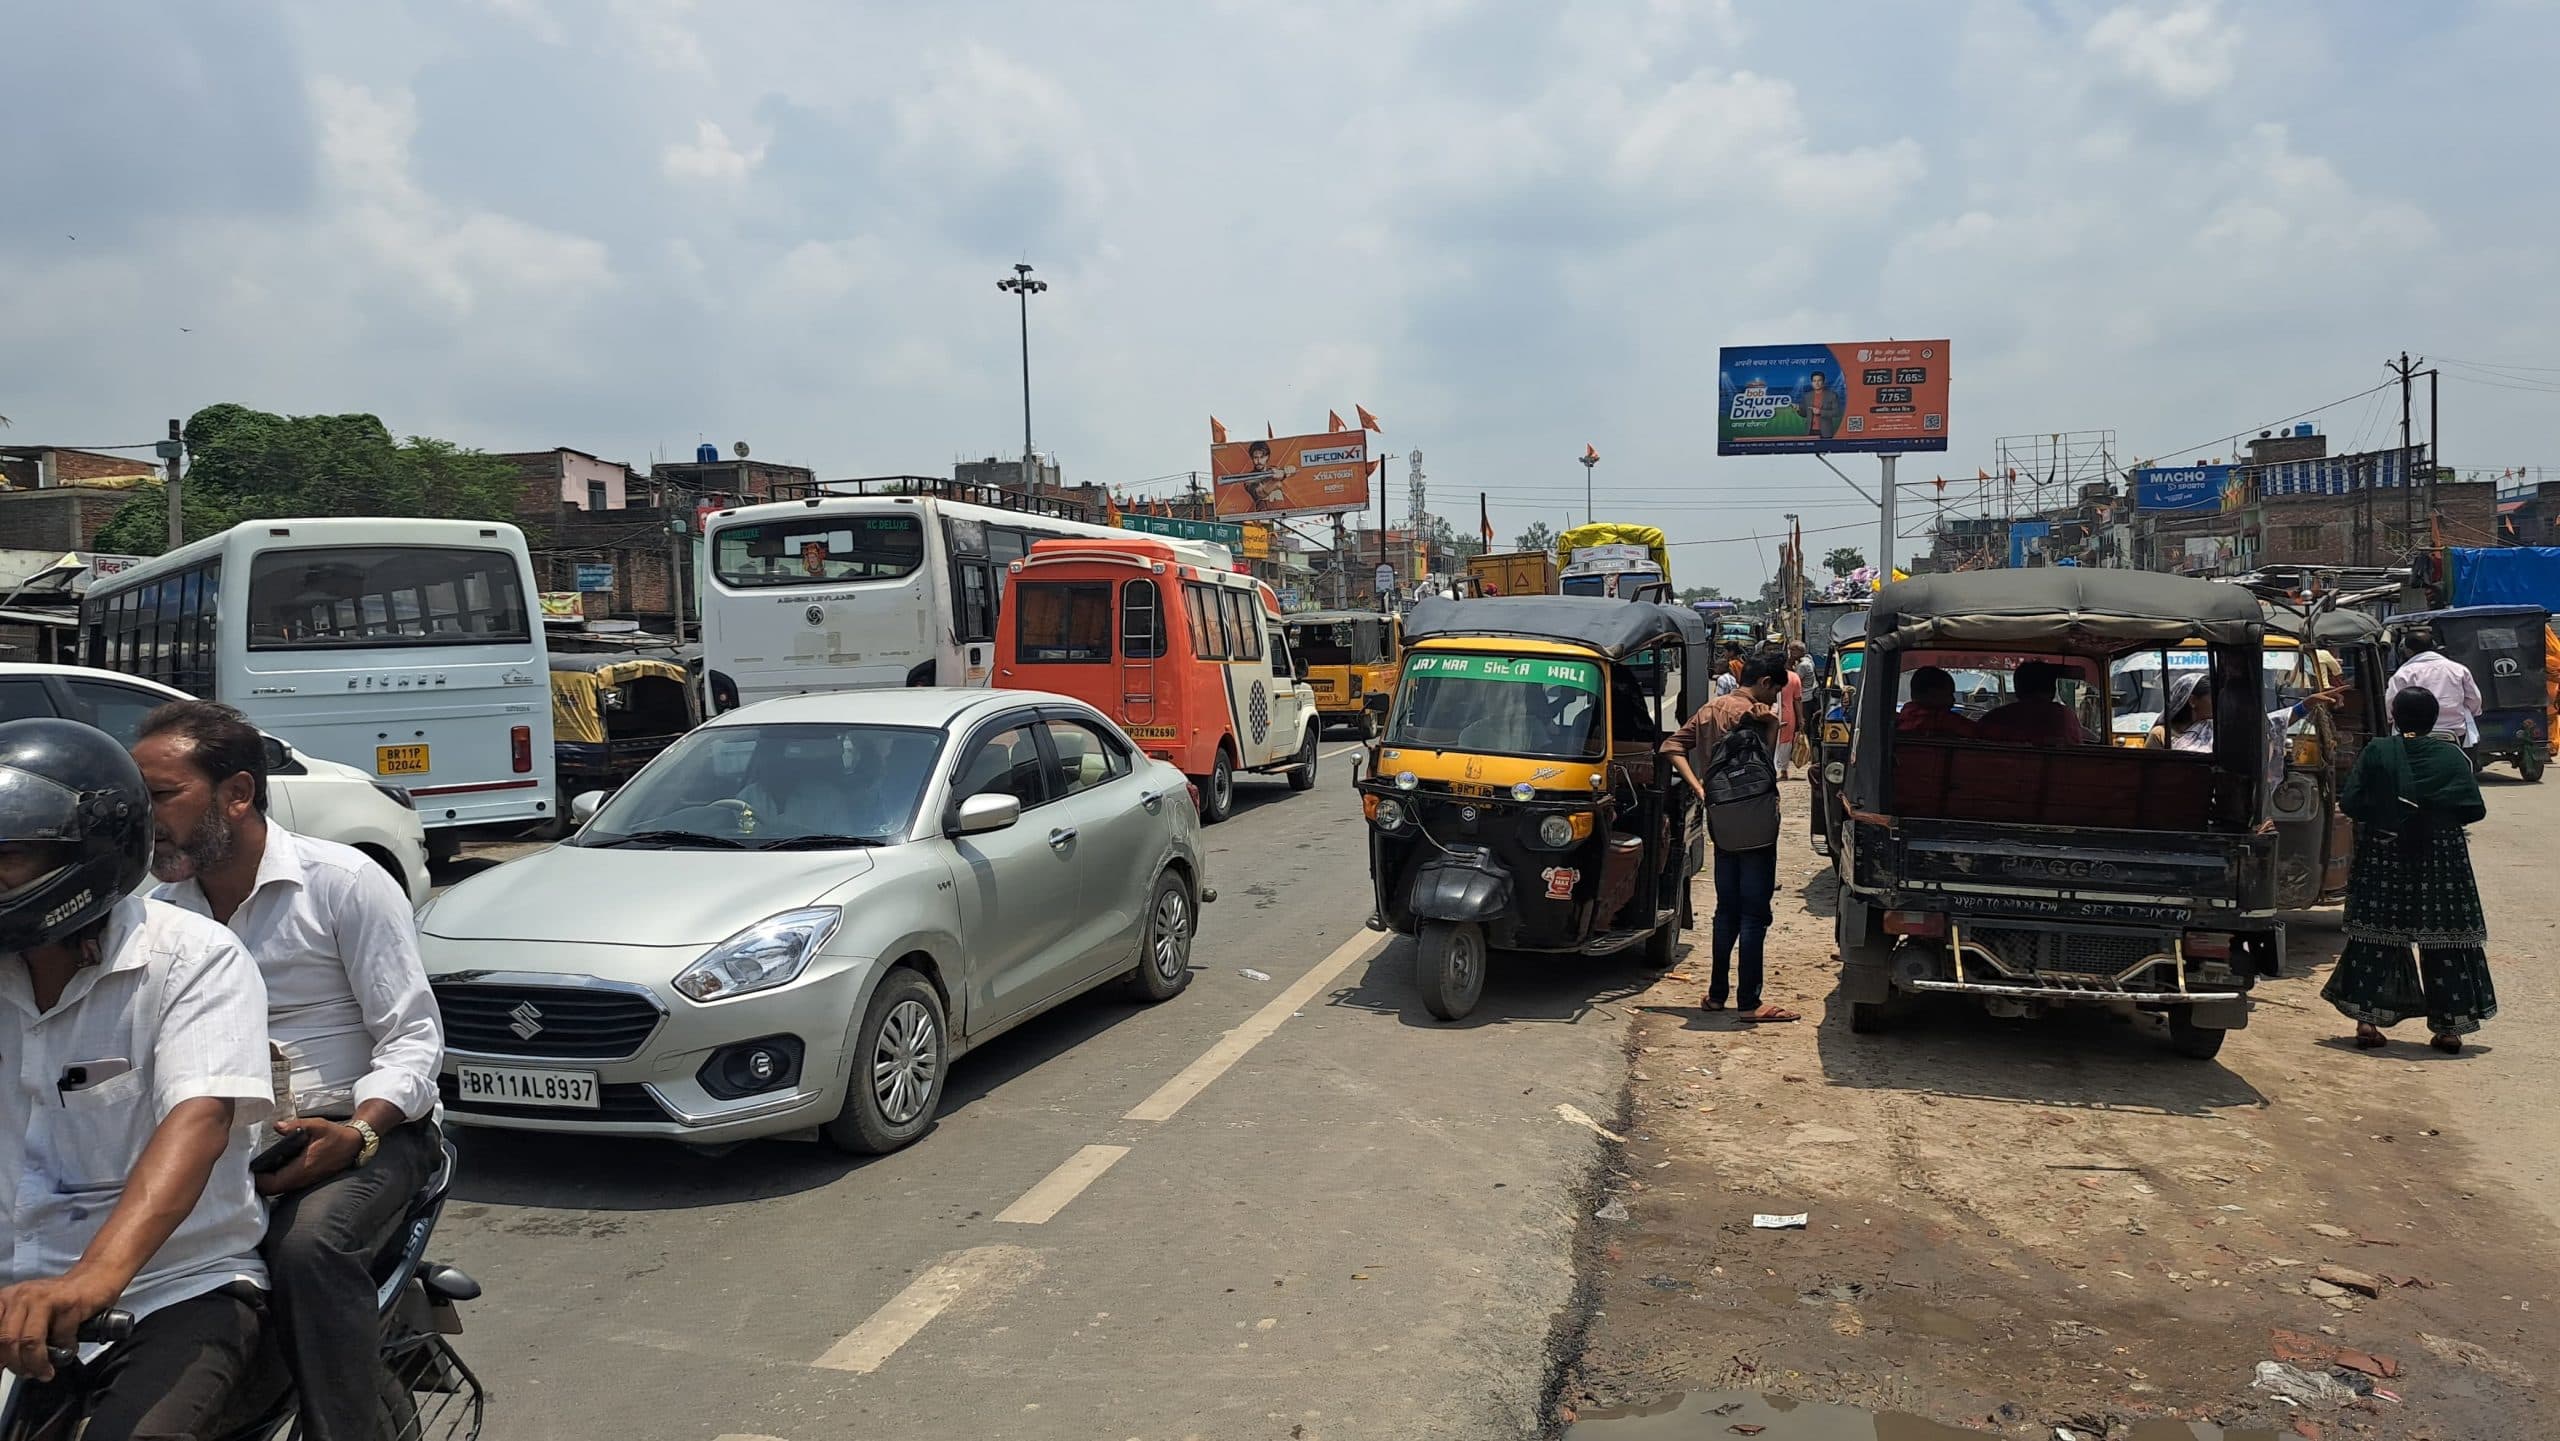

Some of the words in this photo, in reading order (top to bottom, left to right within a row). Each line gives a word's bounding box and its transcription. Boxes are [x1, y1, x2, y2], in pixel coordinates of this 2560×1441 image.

[1898, 374, 1918, 382] 7.65
[1747, 389, 1764, 397] bob
[1880, 393, 1900, 402] 7.75
[1735, 396, 1790, 408] Square
[1733, 407, 1773, 418] Drive
[2150, 471, 2206, 483] MACHO
[879, 519, 911, 531] DELUXE
[1412, 658, 1438, 671] JAY
[1442, 659, 1469, 671] MAA
[1548, 666, 1585, 683] WALI
[348, 673, 447, 689] EICHER
[387, 748, 421, 760] BR11P
[388, 759, 422, 771] D2044
[470, 1071, 593, 1102] BR11AL8937
